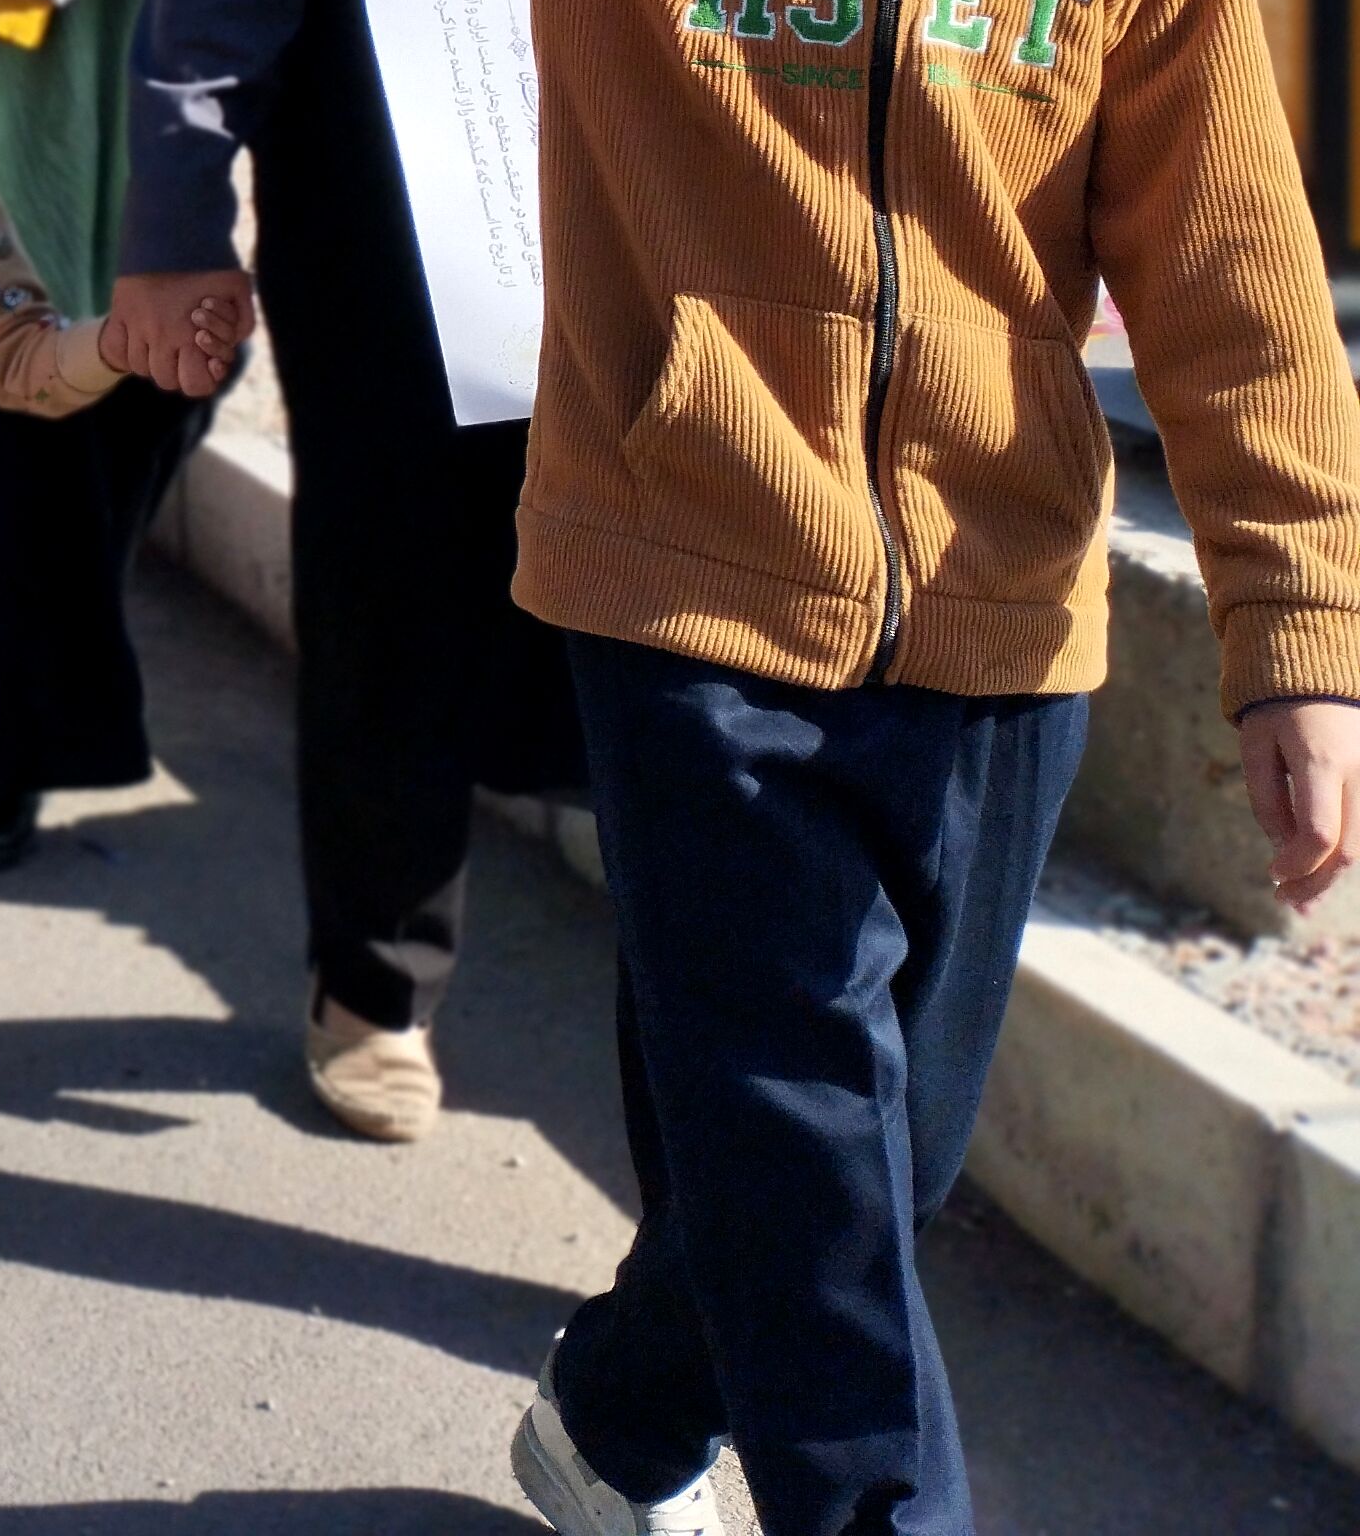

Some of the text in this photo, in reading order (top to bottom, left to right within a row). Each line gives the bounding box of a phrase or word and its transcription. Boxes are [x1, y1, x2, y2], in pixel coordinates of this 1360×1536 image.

[444, 27, 457, 56] جدا
[468, 18, 490, 43] ایران
[478, 46, 494, 75] ملت
[450, 58, 472, 95] آینده
[455, 98, 474, 106] از
[481, 78, 502, 112] رهایی
[457, 109, 475, 117] را
[465, 119, 489, 166] گذشته
[489, 115, 511, 152] مقطع
[476, 169, 493, 185] که
[502, 155, 524, 202] حقیقت
[480, 188, 502, 224] است
[510, 207, 526, 218] در
[489, 227, 502, 240] ما
[514, 222, 539, 247] فجر
[488, 243, 513, 275] تاریخ
[497, 279, 517, 288] از
